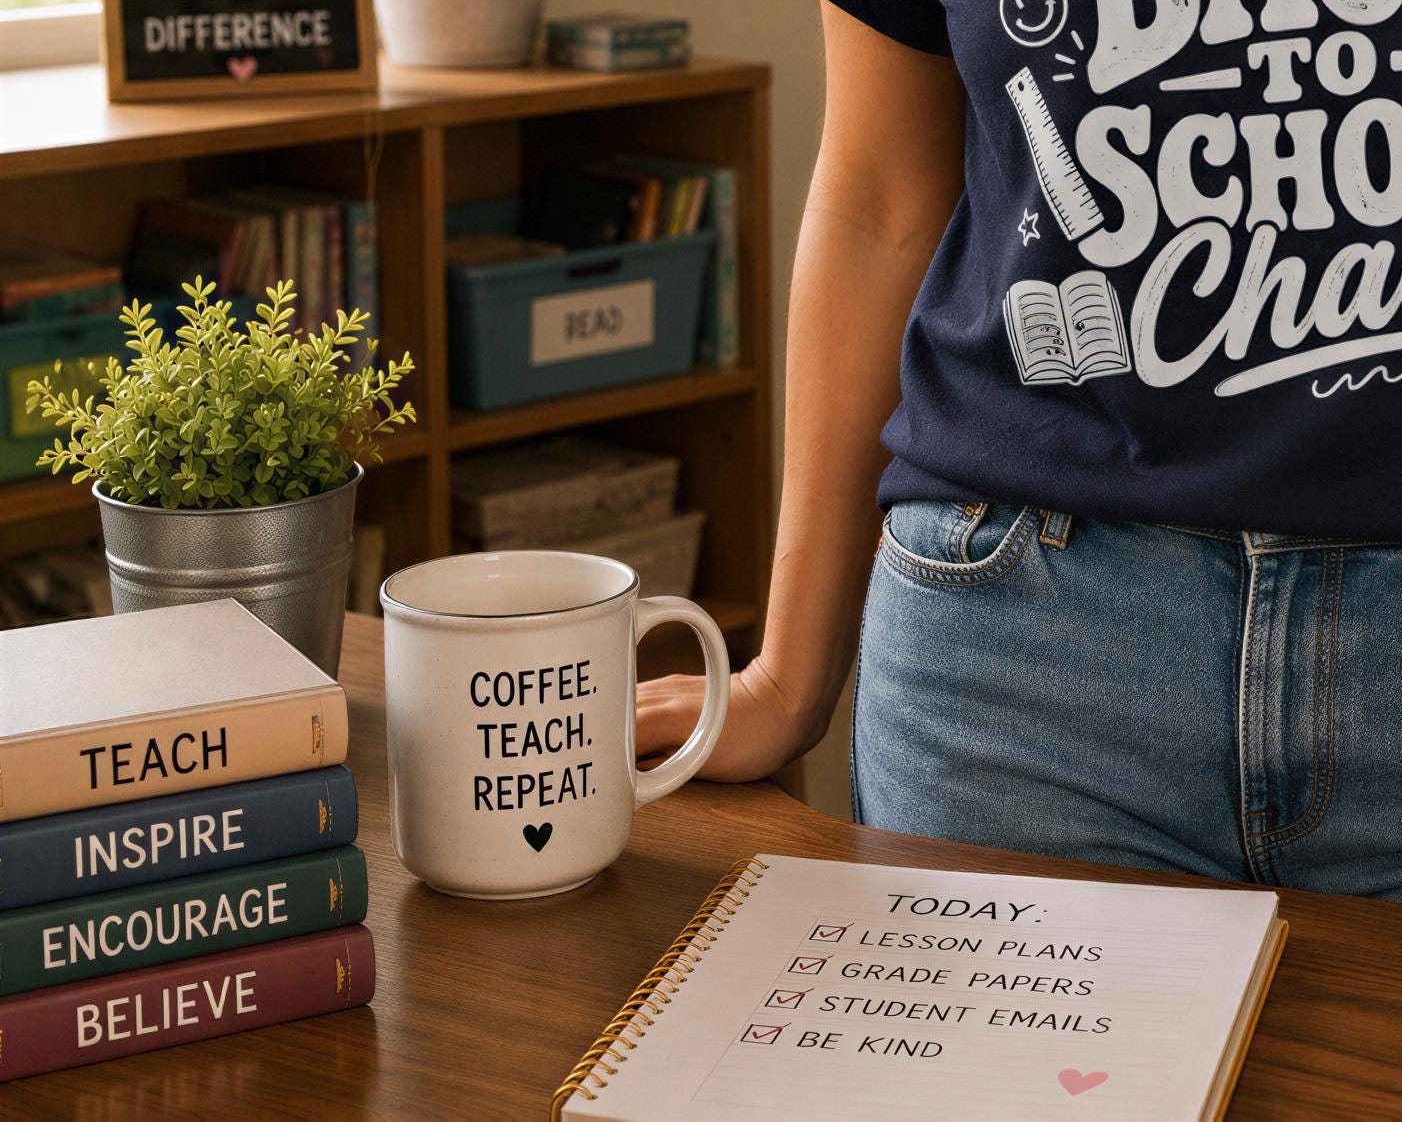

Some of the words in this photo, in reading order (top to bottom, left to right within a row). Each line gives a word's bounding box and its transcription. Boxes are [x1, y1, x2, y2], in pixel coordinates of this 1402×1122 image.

[144, 9, 333, 54] DIFFERENCE
[1247, 31, 1377, 103] TO
[470, 660, 597, 707] COFFEE.
[80, 727, 228, 789] TEACH
[477, 712, 592, 758] TEACH.
[474, 761, 596, 811] REPEAT.
[75, 808, 245, 878] INSPIRE
[43, 882, 289, 970] ENCOURAGE
[886, 893, 1048, 924] TODAY:
[859, 930, 982, 953] LESSON
[997, 941, 1104, 962] PLANS
[841, 962, 952, 986] GRADE
[967, 972, 1095, 996] PAPERS
[76, 970, 257, 1049] BELIEVE
[819, 995, 977, 1023] STUDENT
[987, 1009, 1113, 1034] EMAILS
[796, 1031, 843, 1051] BE
[857, 1037, 943, 1058] KIND
